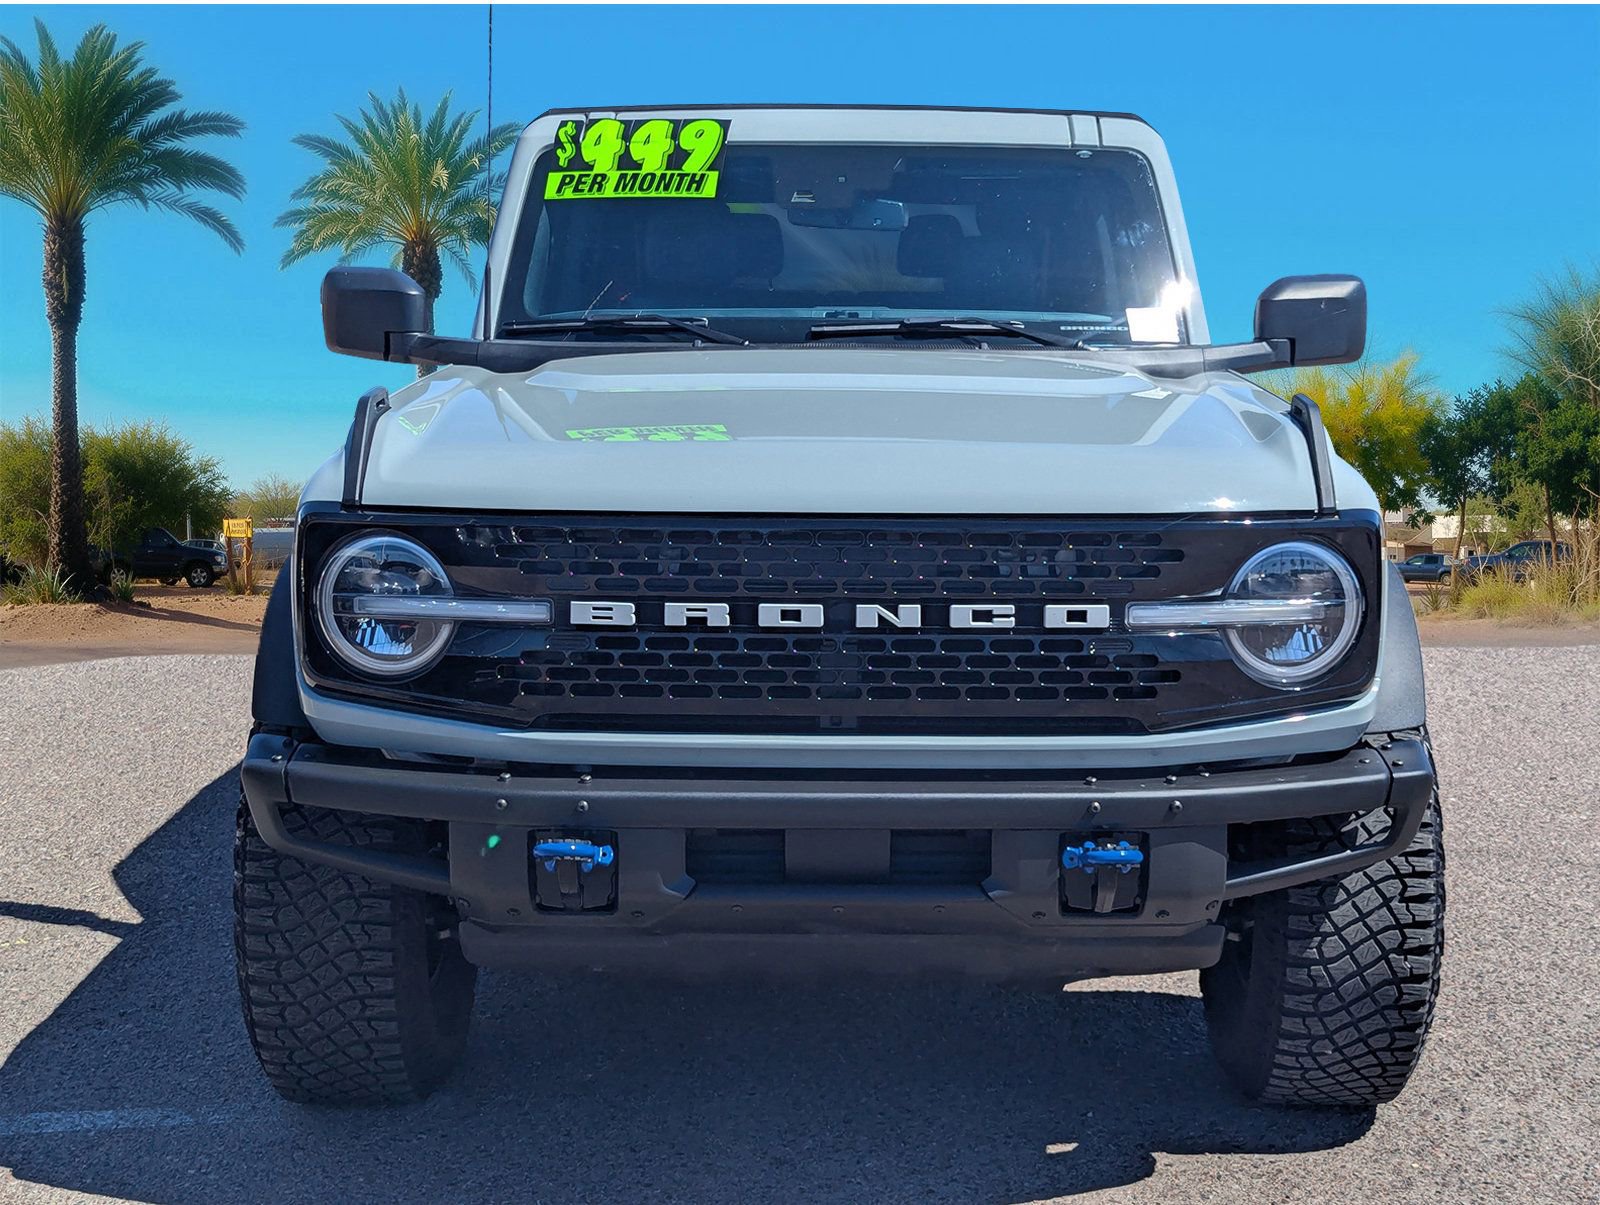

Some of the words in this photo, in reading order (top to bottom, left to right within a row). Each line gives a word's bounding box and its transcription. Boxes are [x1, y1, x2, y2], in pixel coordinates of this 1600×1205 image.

[556, 118, 724, 172] $449
[556, 173, 607, 195] PER
[613, 172, 709, 194] MONTH
[570, 601, 1110, 628] BRONCO
